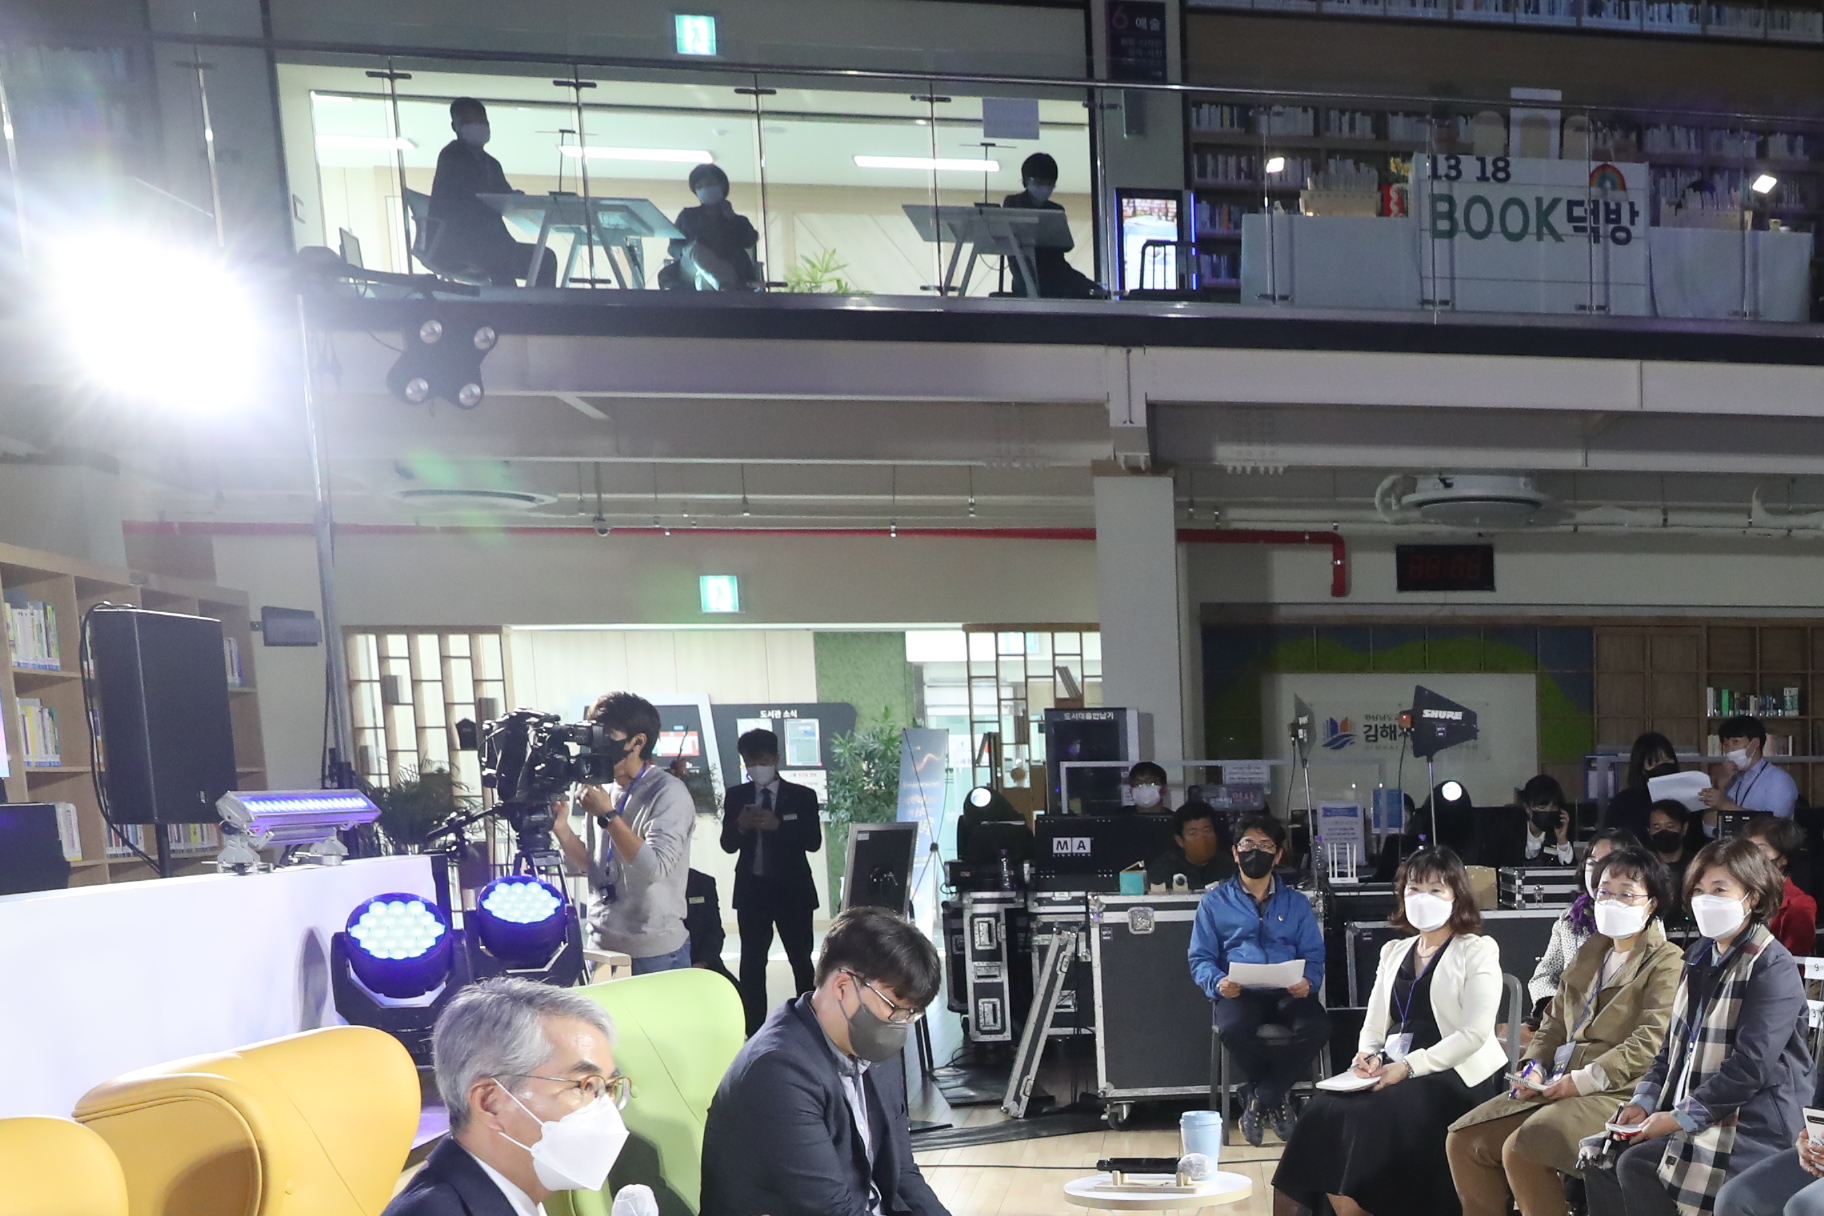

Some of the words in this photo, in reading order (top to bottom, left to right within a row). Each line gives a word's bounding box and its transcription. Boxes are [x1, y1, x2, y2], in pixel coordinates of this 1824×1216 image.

[1429, 154, 1463, 182] 13
[1475, 156, 1512, 183] 18
[760, 709, 782, 719] 도서관
[783, 709, 798, 719] 소식
[1422, 709, 1463, 721] SHURE
[1055, 839, 1088, 852] MA
